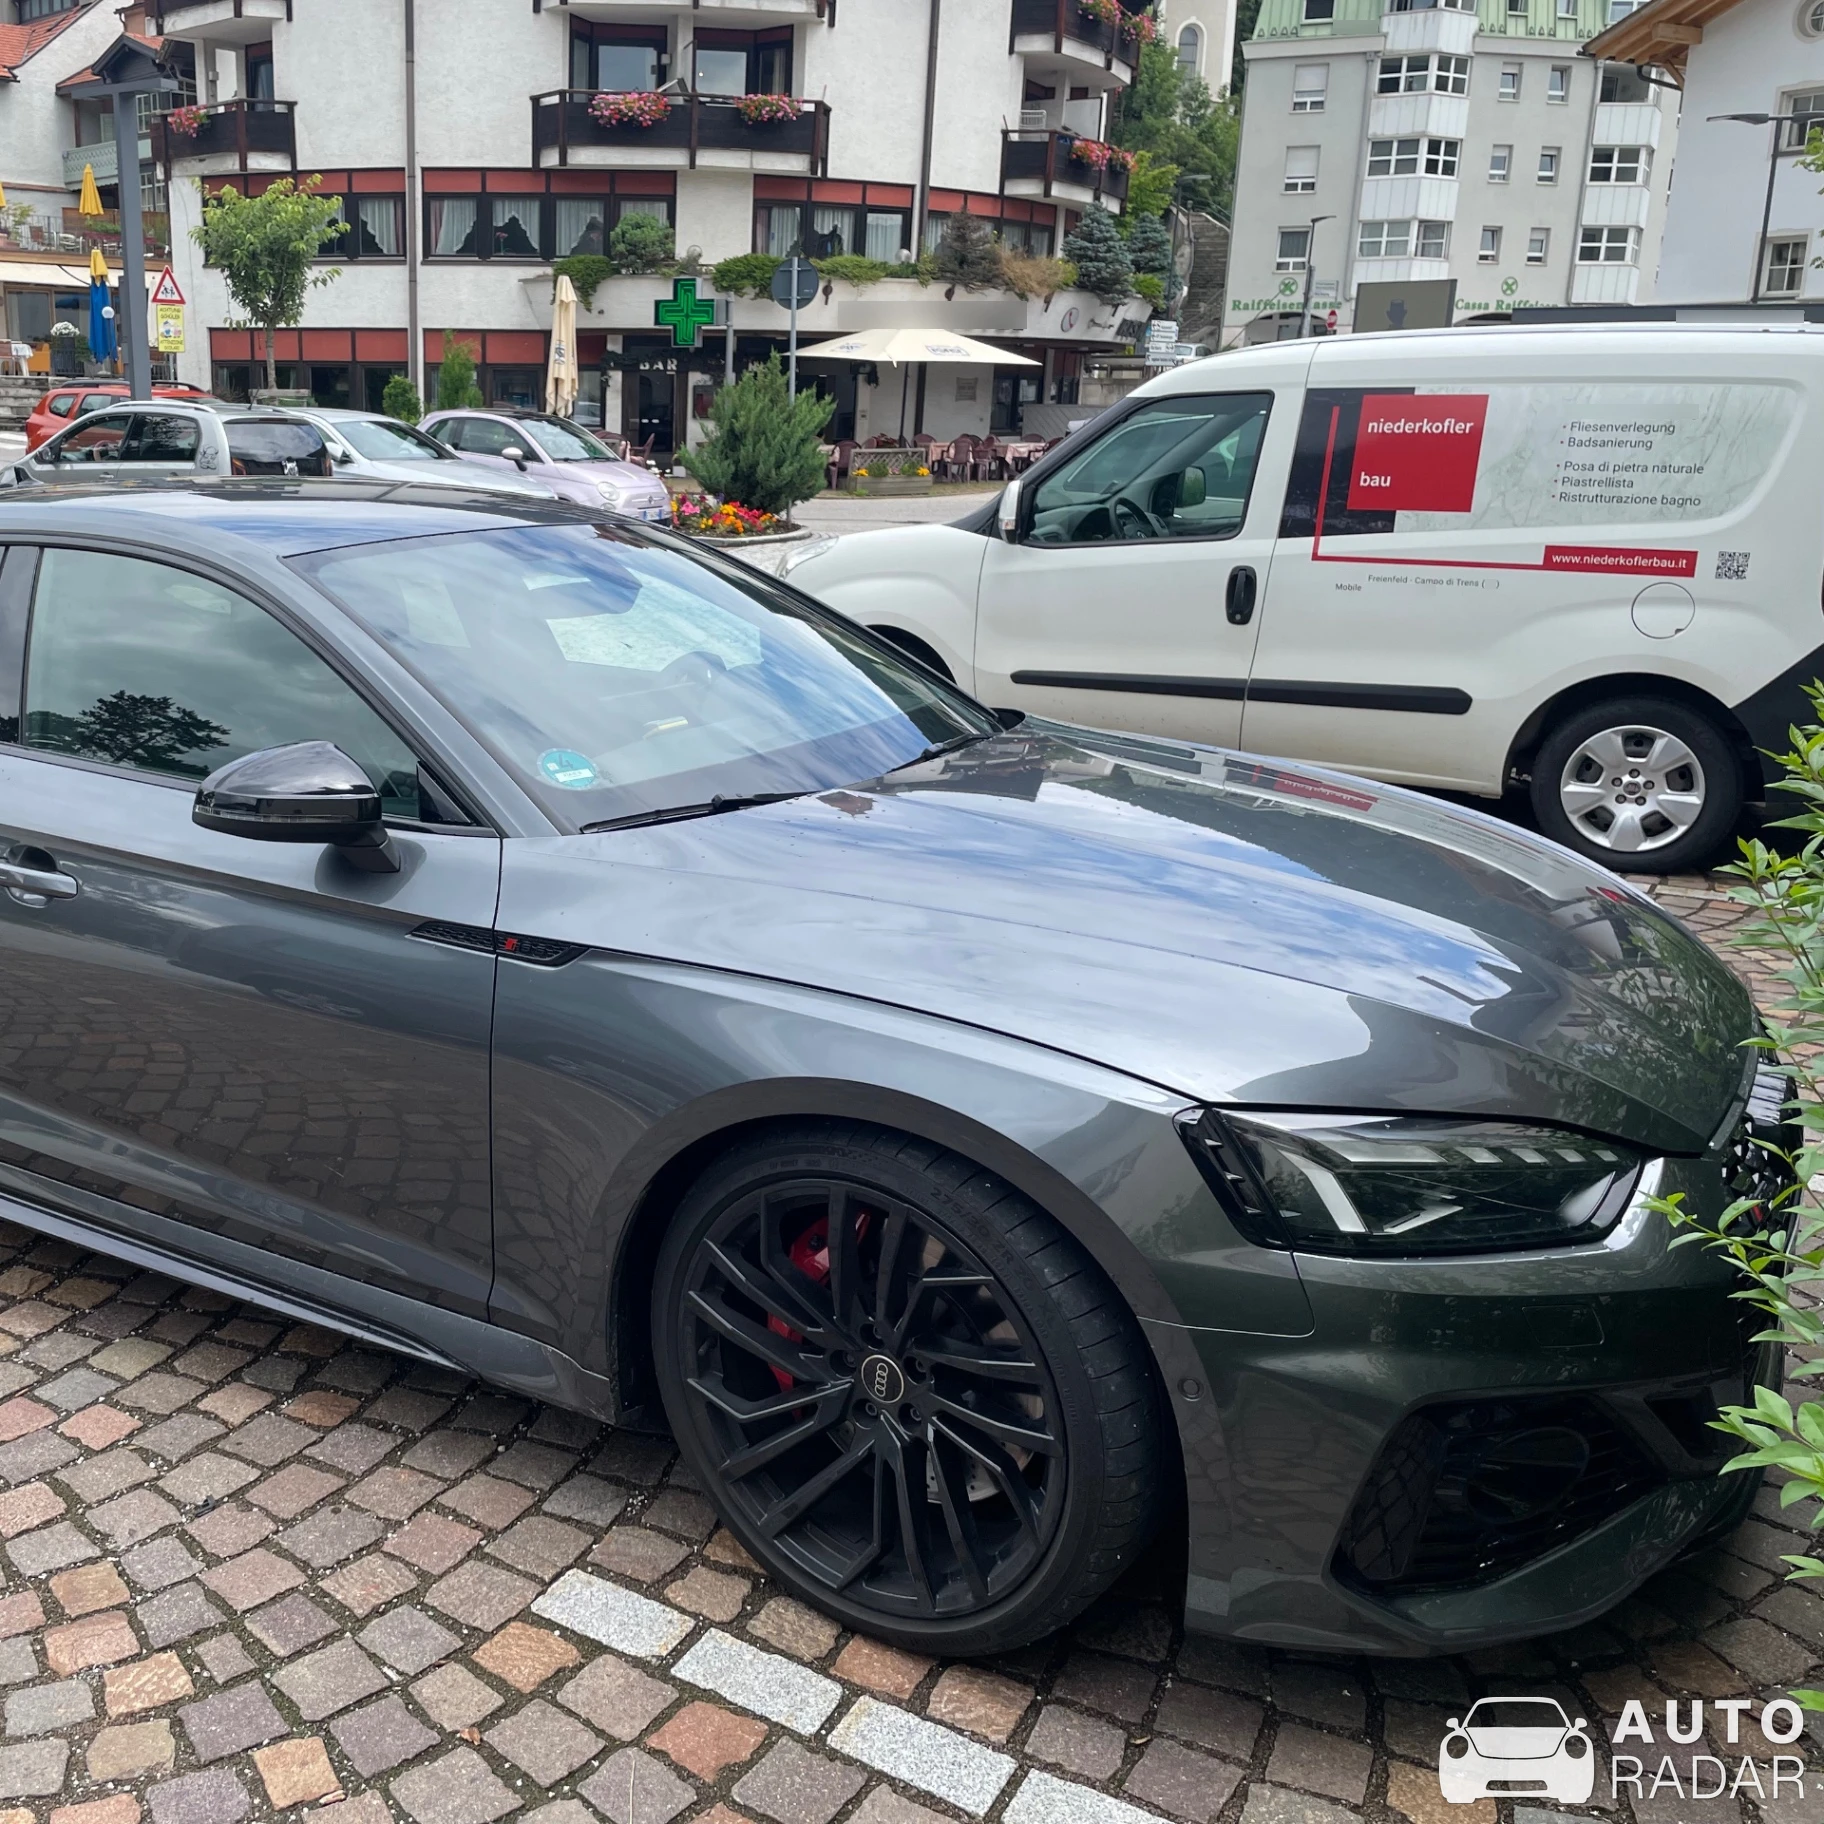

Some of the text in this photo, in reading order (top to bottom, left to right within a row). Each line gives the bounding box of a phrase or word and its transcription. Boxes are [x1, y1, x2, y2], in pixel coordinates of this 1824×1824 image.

[1231, 299, 1343, 311] Raiffeisenasse
[1455, 298, 1489, 310] Cassa
[639, 358, 678, 371] BAR
[1367, 418, 1474, 434] niederkofler
[1570, 421, 1676, 435] Fliesenverlegung
[1567, 436, 1653, 450] Badsanierung
[1564, 460, 1705, 475] Posa di pietra naturale
[1359, 471, 1391, 487] bau
[1561, 476, 1634, 489] Piastrellista
[1559, 491, 1701, 509] Ristrutturazione bagno
[1551, 554, 1687, 569] www.niederkoflerbau.it
[1335, 583, 1362, 592] Mobile
[1367, 574, 1408, 584] Freienfeld
[1414, 576, 1444, 586] Campo
[1446, 577, 1454, 586] di
[1456, 578, 1479, 588] Trens
